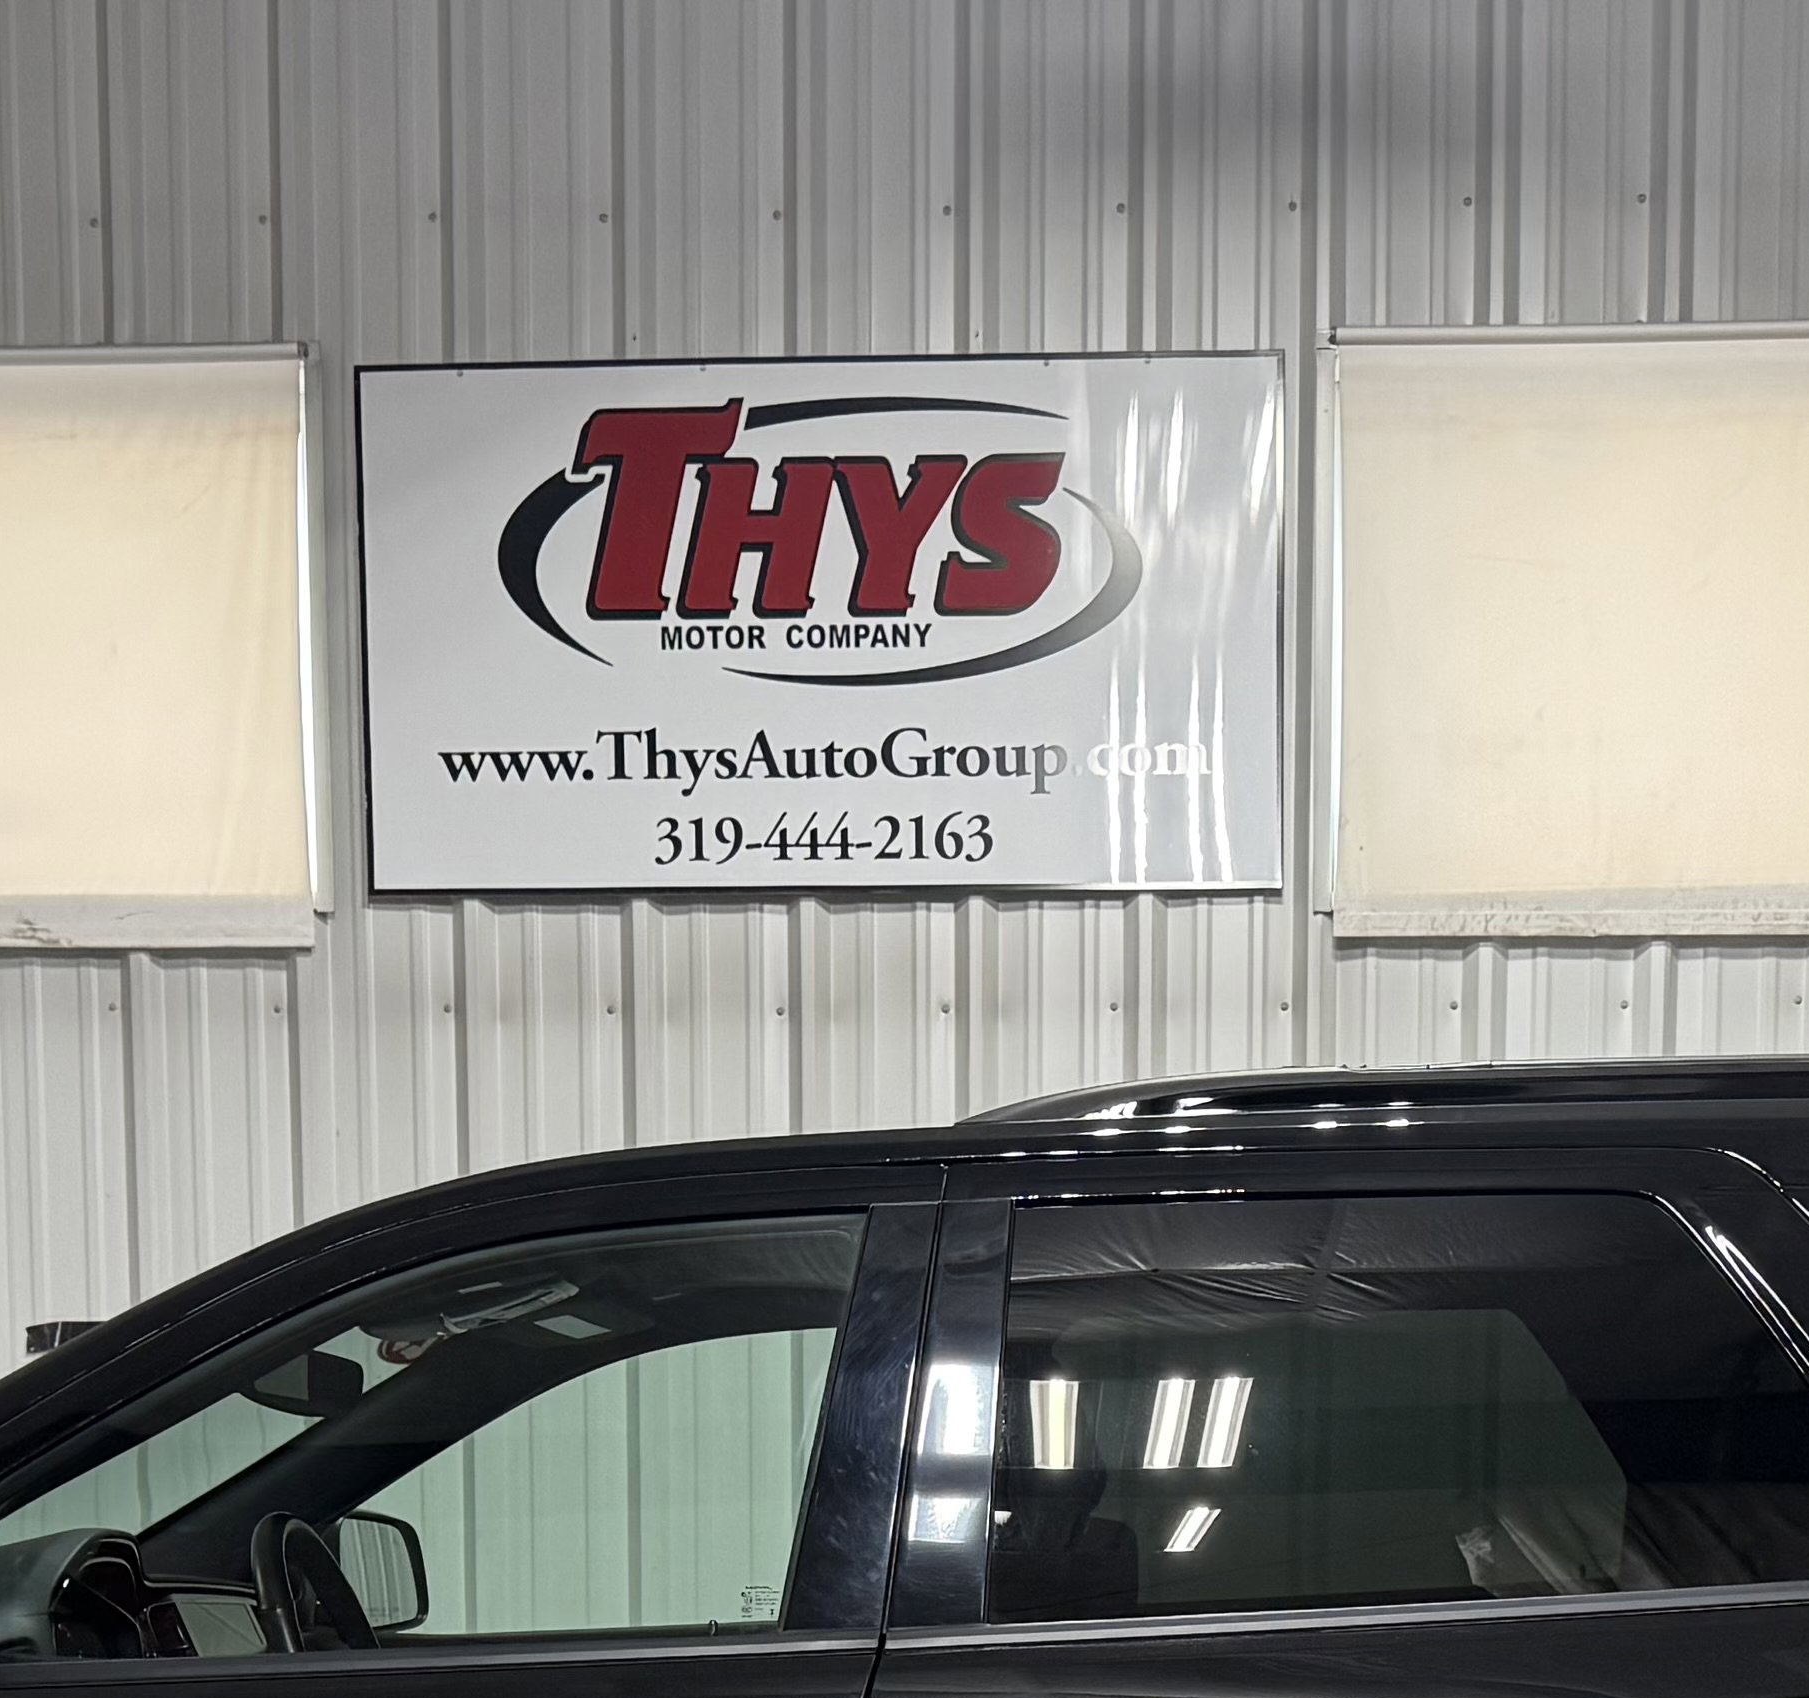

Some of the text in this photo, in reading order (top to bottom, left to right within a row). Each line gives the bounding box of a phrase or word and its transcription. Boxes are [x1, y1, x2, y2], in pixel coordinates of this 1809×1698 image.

[565, 397, 1066, 622] THYS
[660, 622, 933, 651] MOTOR COMPANY
[437, 727, 1209, 797] www.ThysAutoGroup.com
[653, 811, 994, 866] 319-444-2163
